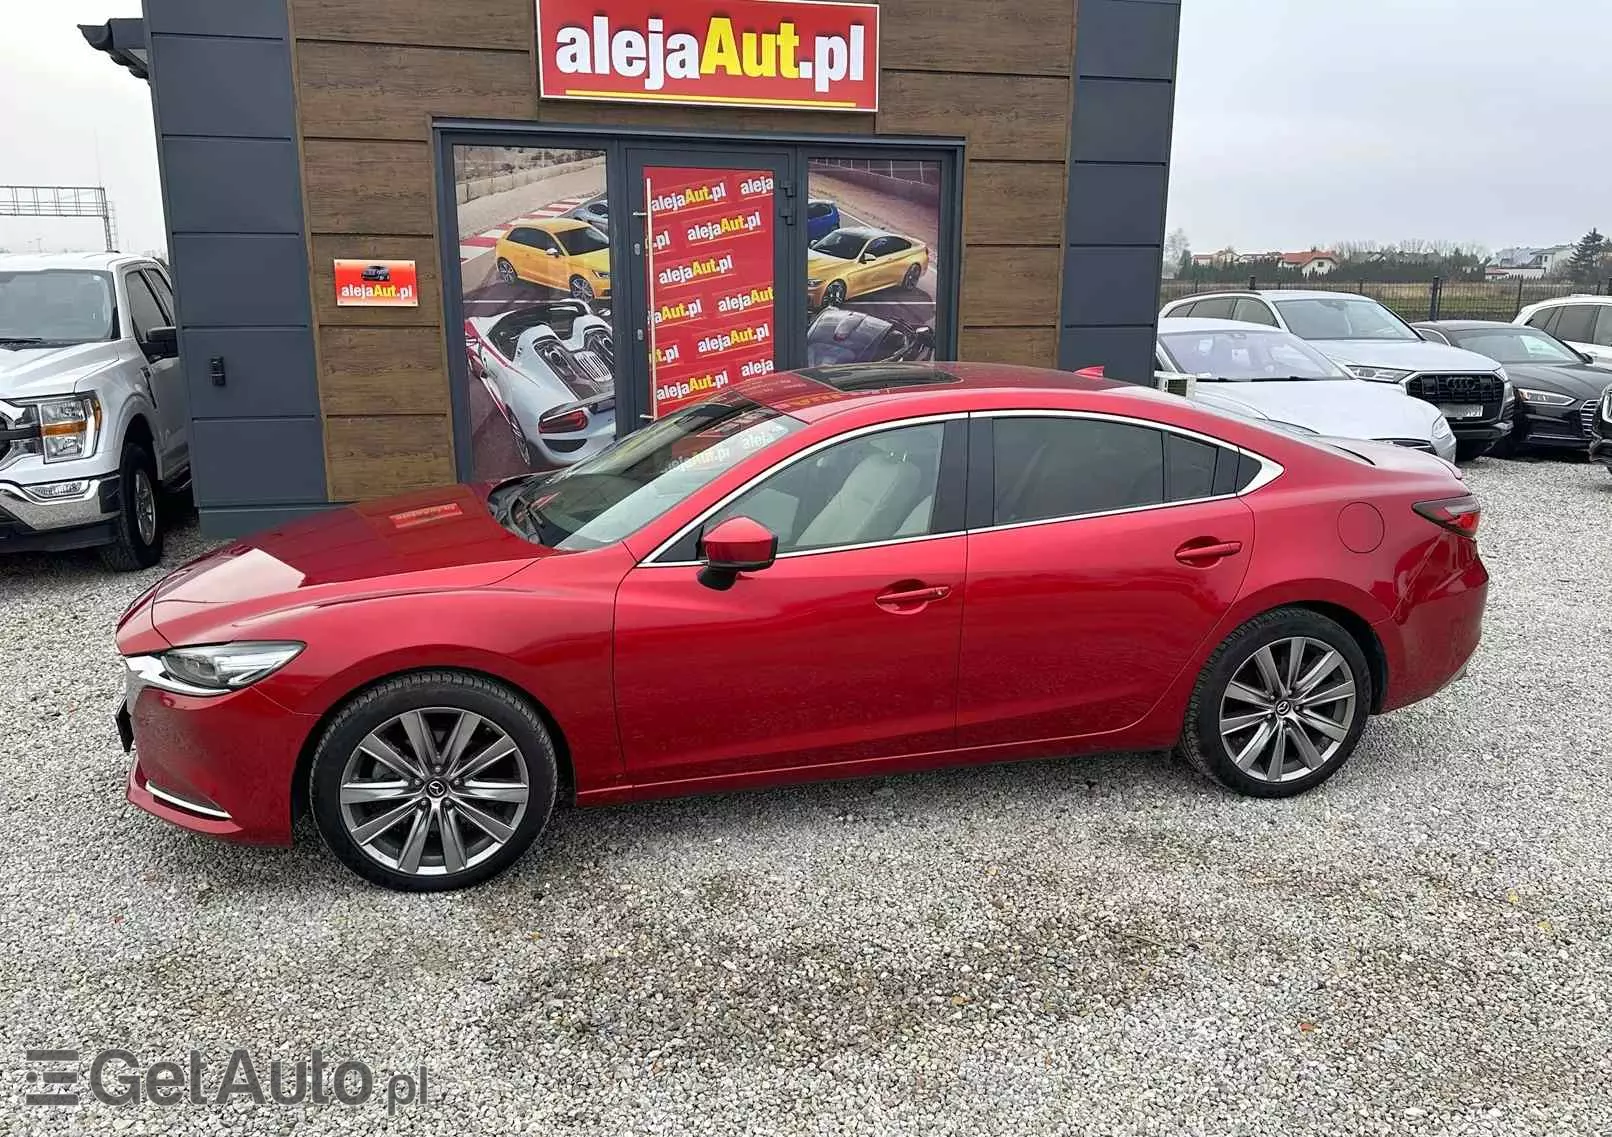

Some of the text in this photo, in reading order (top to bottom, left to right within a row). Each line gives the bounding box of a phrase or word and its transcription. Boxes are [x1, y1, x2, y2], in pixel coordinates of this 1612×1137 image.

[555, 15, 865, 93] alejaAut.pl
[651, 182, 727, 212] alejaAut.pl
[687, 211, 761, 241] alejaAut.pl
[658, 254, 733, 284] alejaAut.pl
[341, 284, 413, 301] alejaAut.pl
[697, 323, 770, 353] alejaAut.pl
[656, 370, 729, 400] alejaAut.pl
